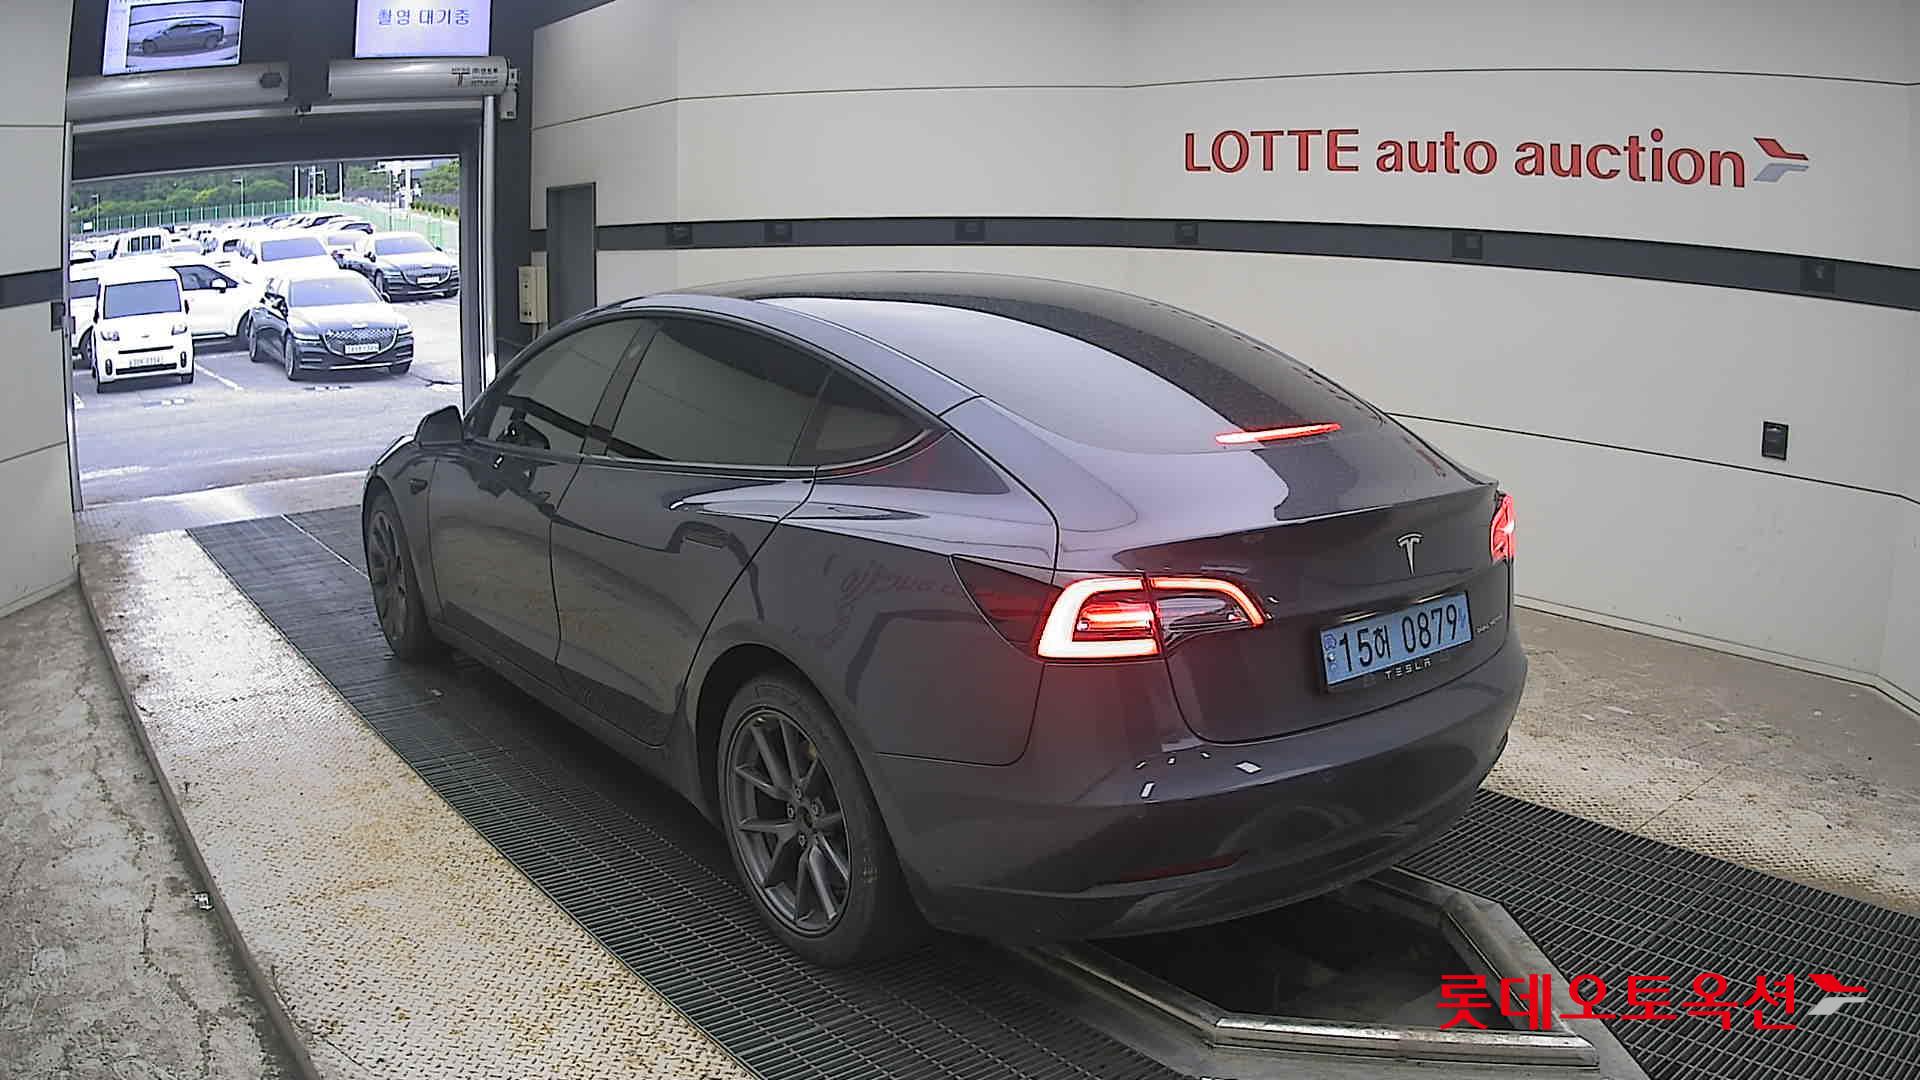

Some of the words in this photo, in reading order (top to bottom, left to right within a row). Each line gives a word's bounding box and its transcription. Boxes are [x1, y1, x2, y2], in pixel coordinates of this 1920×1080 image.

[419, 9, 469, 25] 대기중
[1184, 129, 1360, 173] LOTTE
[1375, 130, 1498, 175] auto
[1514, 128, 1746, 188] auction
[1339, 624, 1392, 672] 15허
[1401, 604, 1457, 653] 0879
[1384, 657, 1432, 680] TESLA
